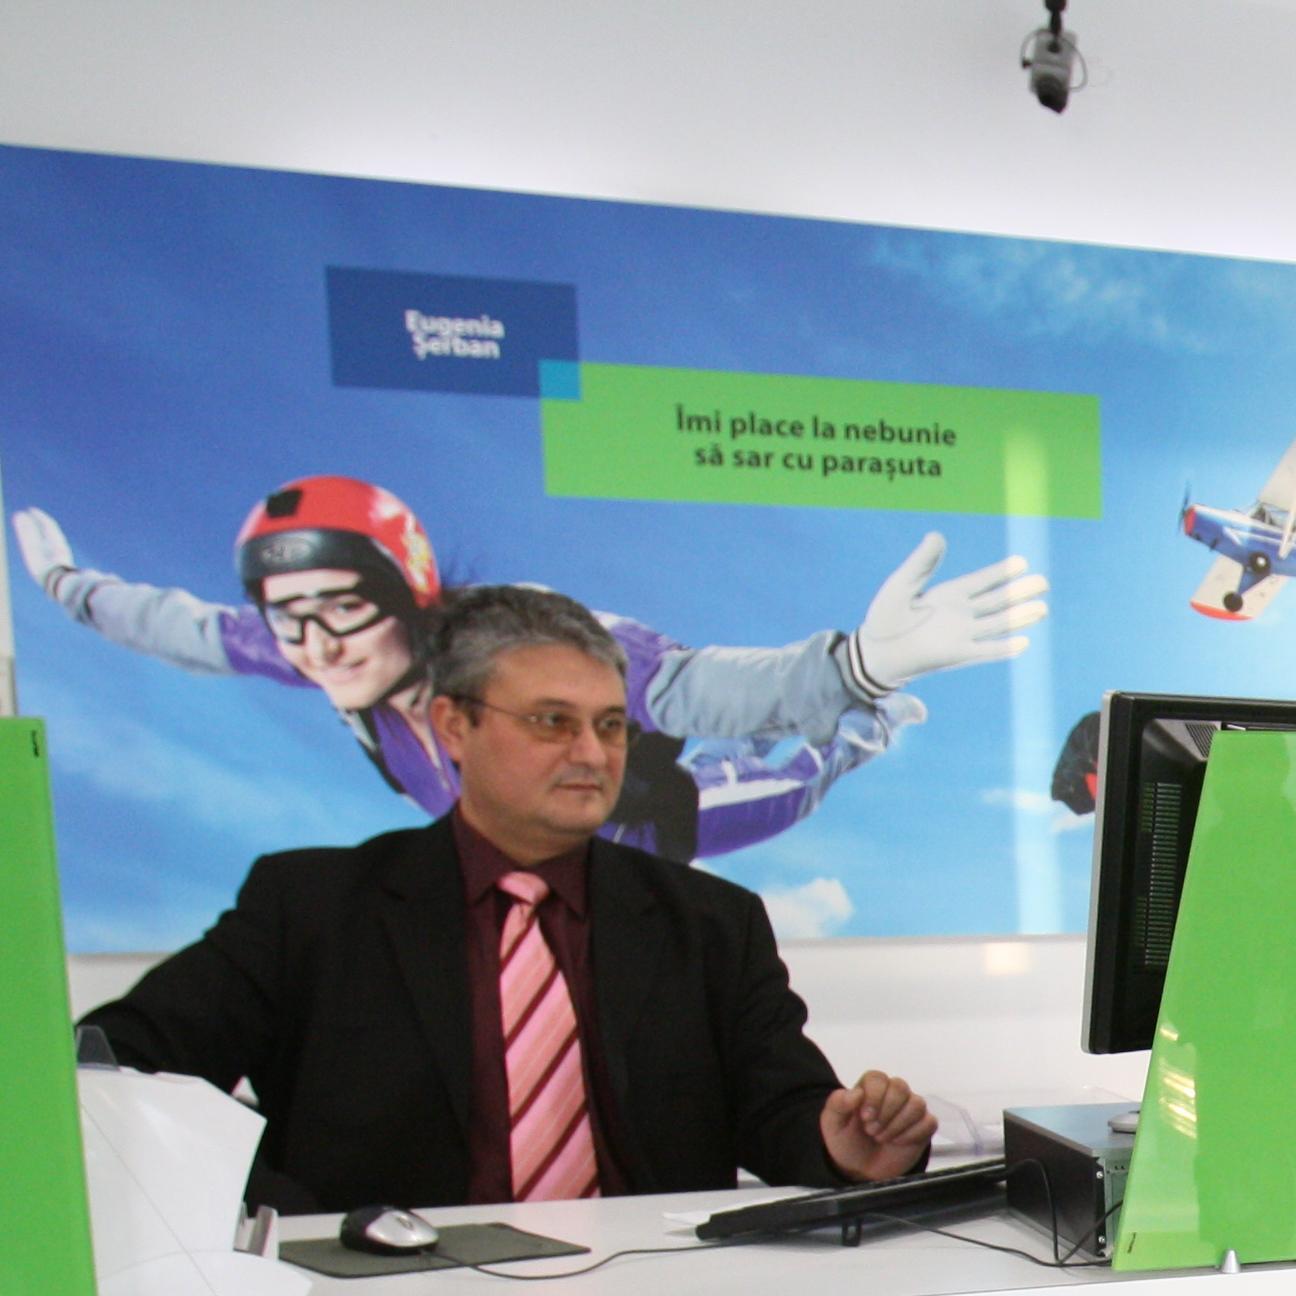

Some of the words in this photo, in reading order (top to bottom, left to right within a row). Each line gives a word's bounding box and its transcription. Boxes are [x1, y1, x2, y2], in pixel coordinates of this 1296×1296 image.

[404, 309, 505, 341] Eugenia
[676, 403, 721, 433] Îmi
[730, 411, 805, 440] place
[812, 415, 836, 439] la
[844, 419, 957, 446] nebunie
[694, 444, 725, 467] să
[732, 449, 774, 469] sar
[782, 452, 813, 471] cu
